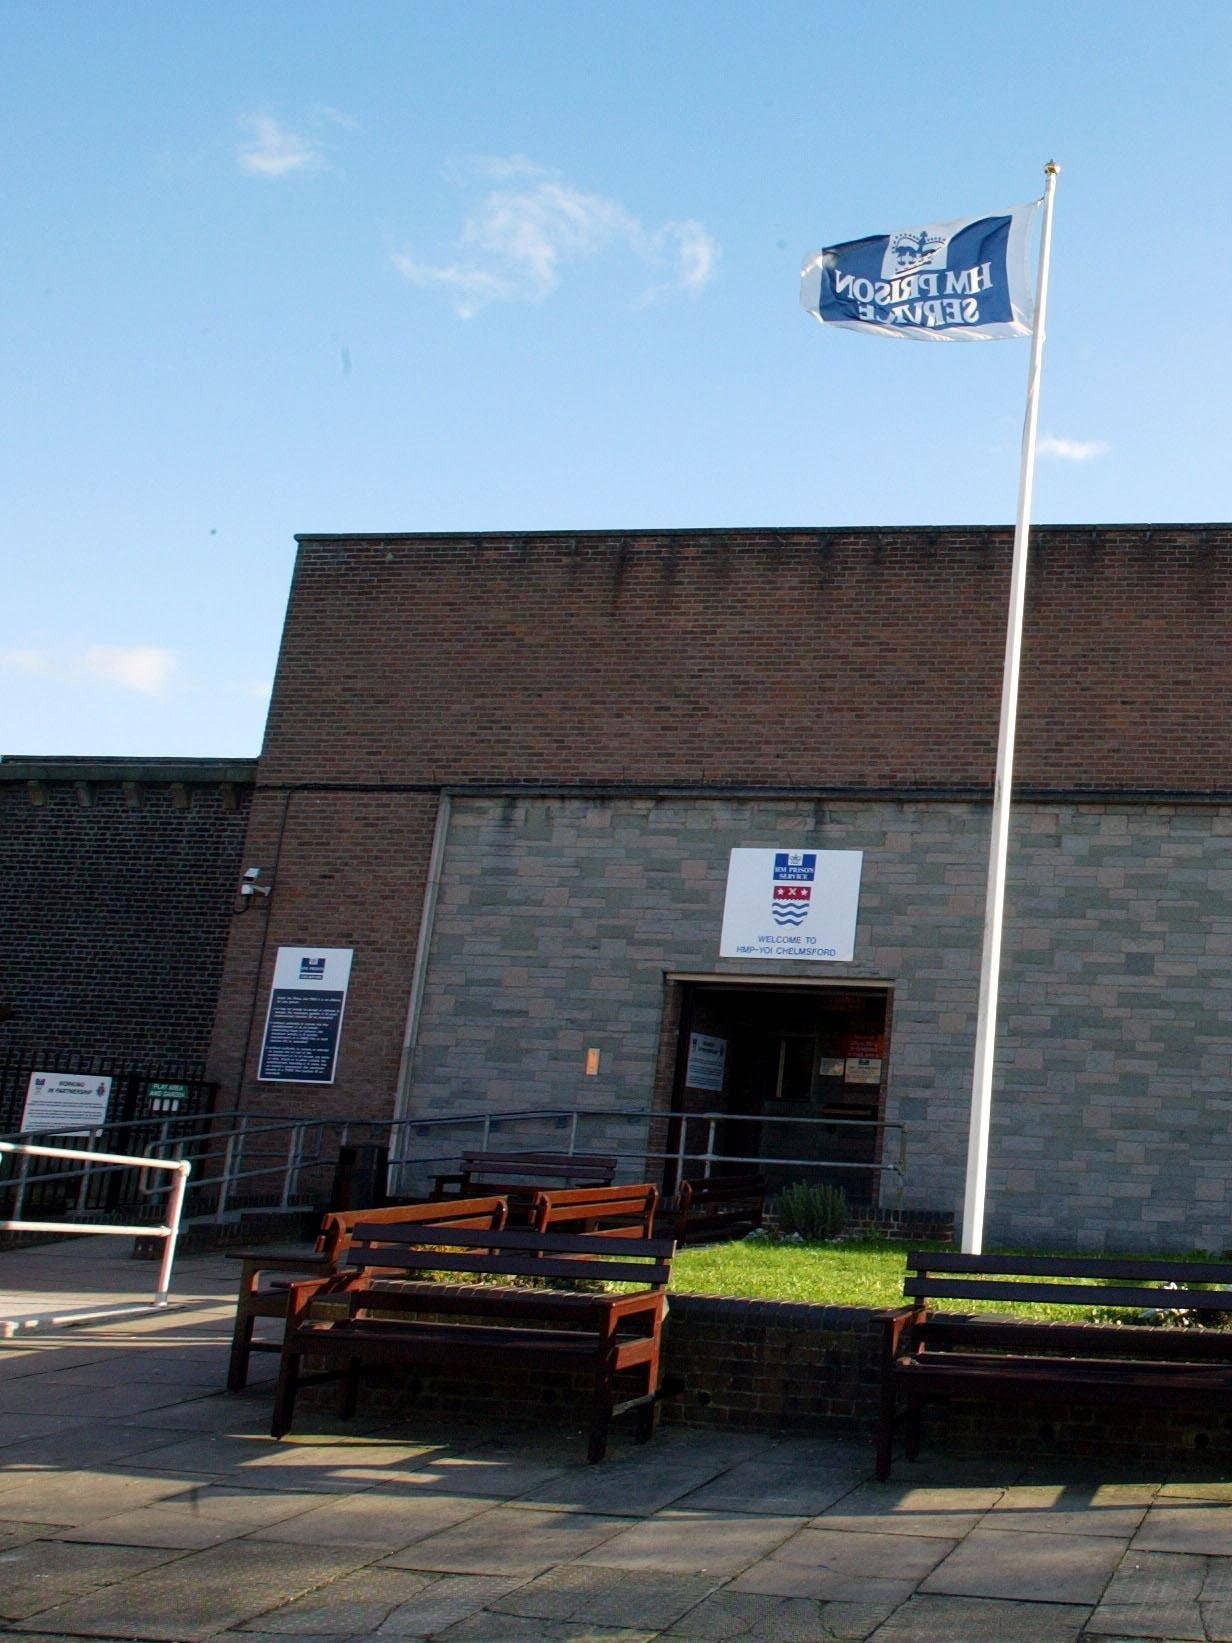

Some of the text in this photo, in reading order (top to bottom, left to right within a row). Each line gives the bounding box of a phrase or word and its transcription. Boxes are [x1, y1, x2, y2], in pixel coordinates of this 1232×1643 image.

[758, 935, 817, 945] WELCOME TO
[775, 946, 836, 957] CHELMSFORD
